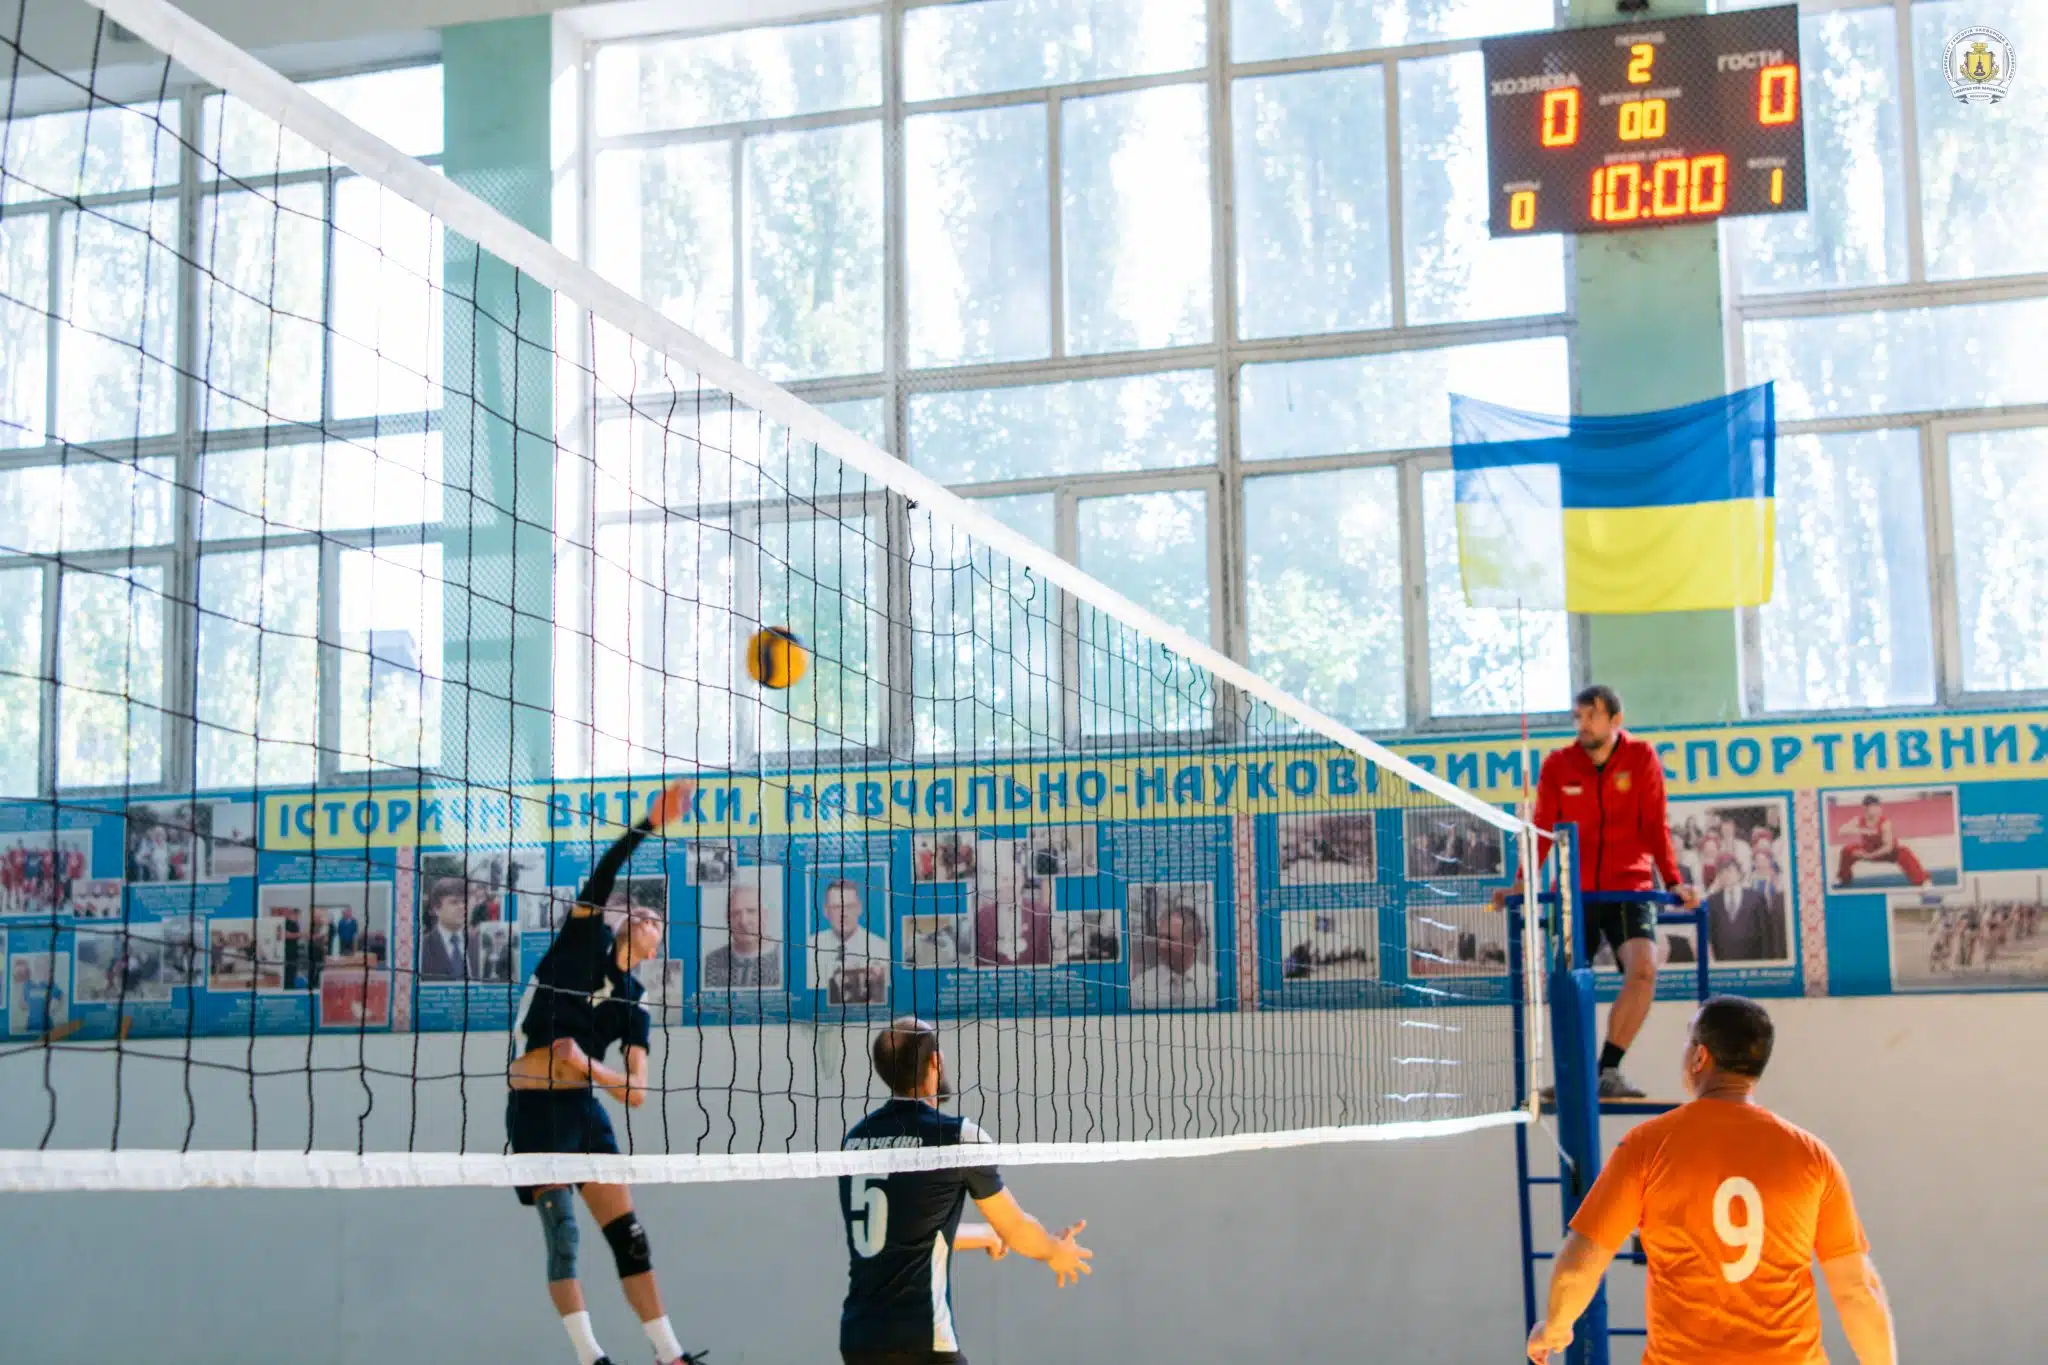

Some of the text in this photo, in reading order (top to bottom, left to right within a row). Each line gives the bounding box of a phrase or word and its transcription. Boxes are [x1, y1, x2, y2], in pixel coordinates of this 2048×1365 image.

[1628, 43, 1654, 84] 2
[1717, 49, 1784, 73] ГОСТИ
[1542, 88, 1579, 147] 0
[1619, 99, 1666, 141] 00
[1758, 64, 1798, 124] 0
[1510, 191, 1536, 230] 0
[1590, 154, 1727, 222] 10:00
[1770, 168, 1783, 204] 1
[784, 759, 1378, 824] НАВЧАЛЬНО-НАУКОВІ
[850, 1173, 889, 1259] 5
[1712, 1175, 1765, 1284] 9
